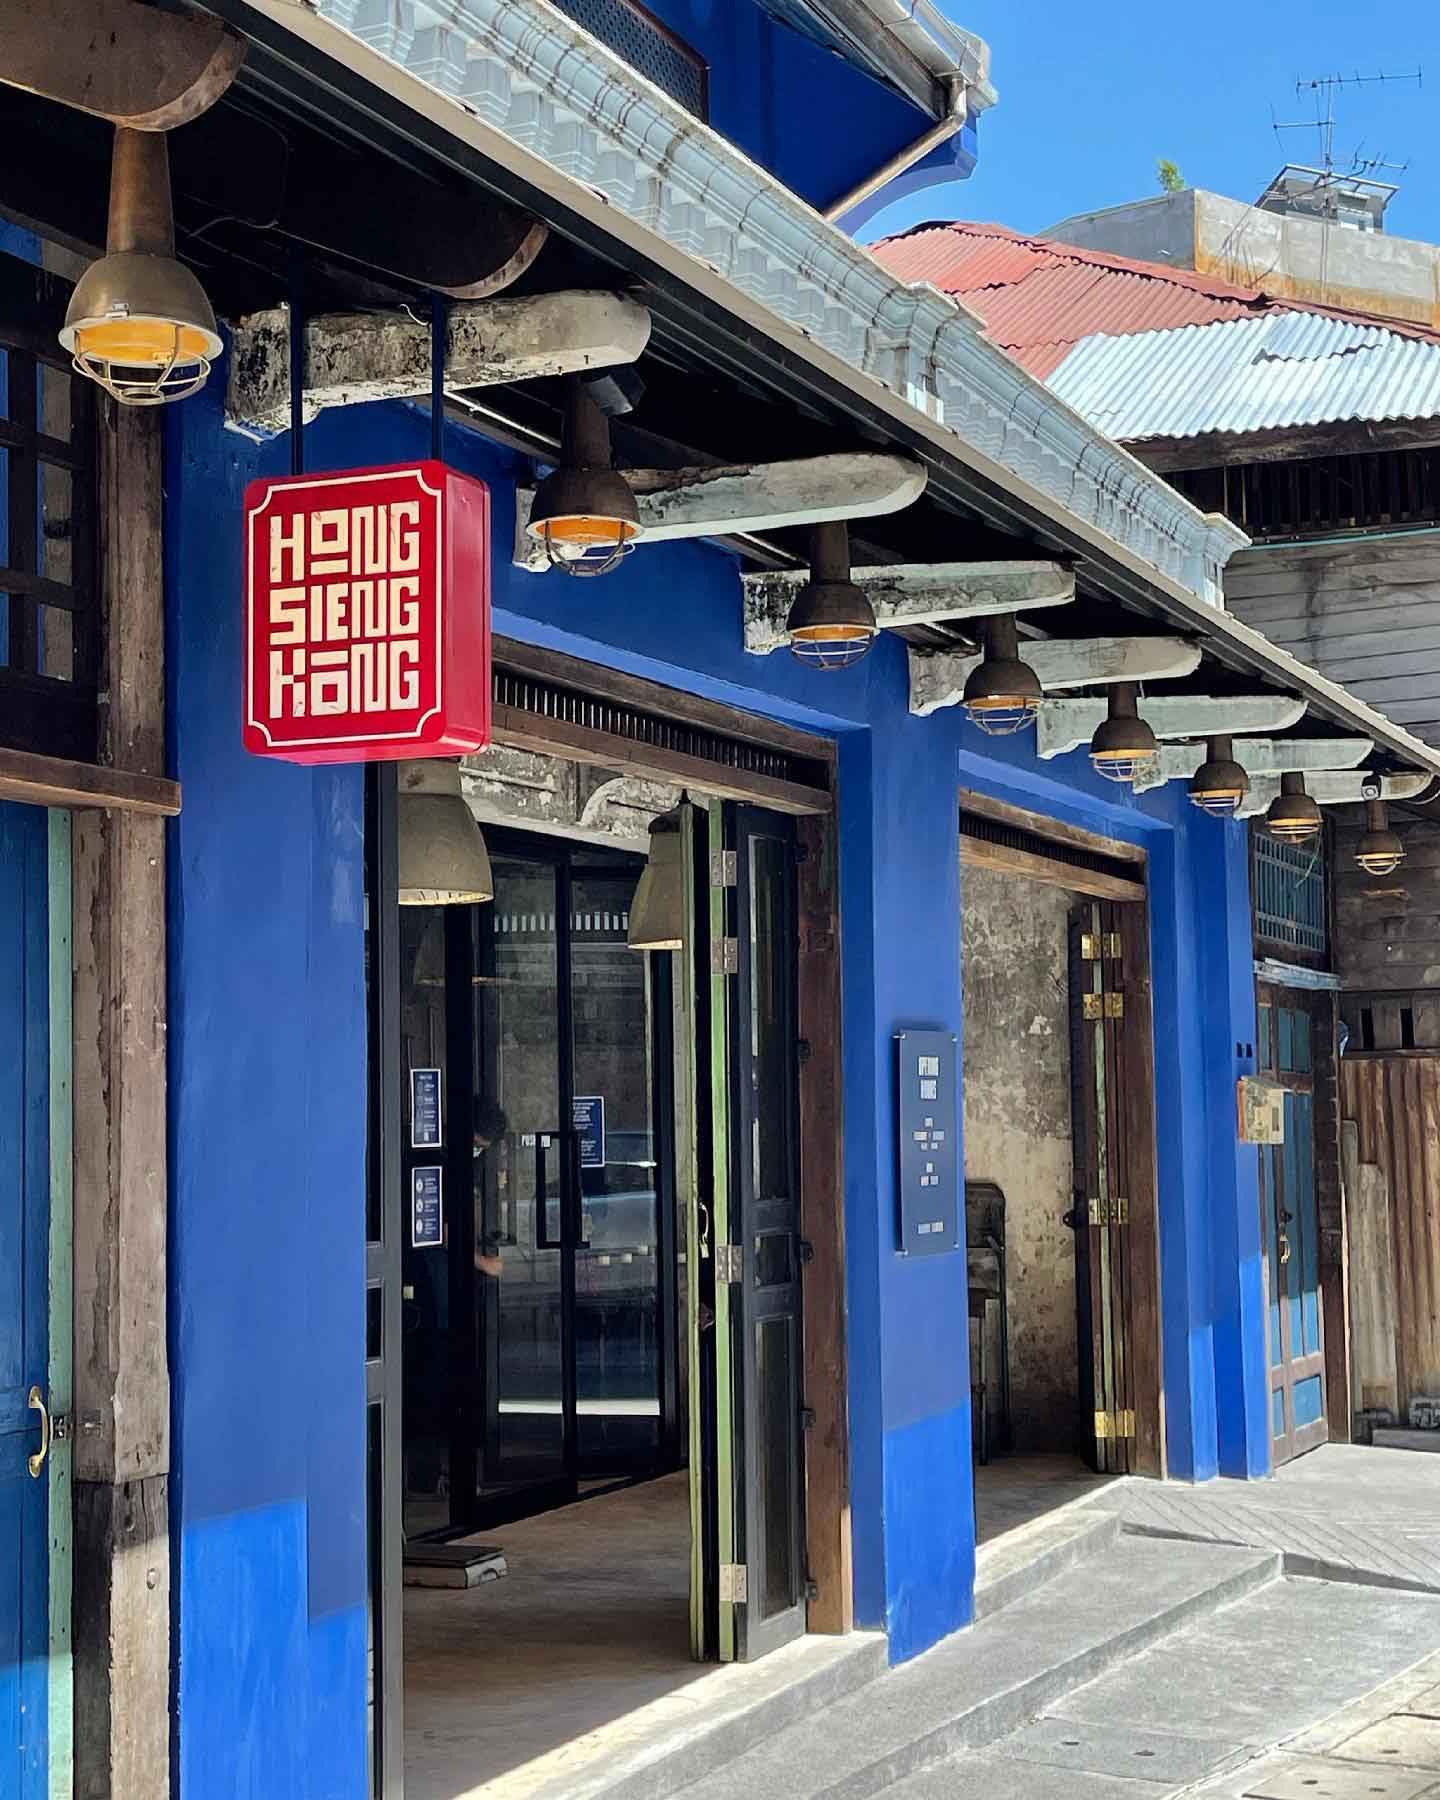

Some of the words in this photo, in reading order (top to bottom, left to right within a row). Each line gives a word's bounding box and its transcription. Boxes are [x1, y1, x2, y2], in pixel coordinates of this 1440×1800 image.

[270, 501, 420, 583] HONG
[270, 576, 420, 645] SIENG
[270, 640, 420, 719] KONG
